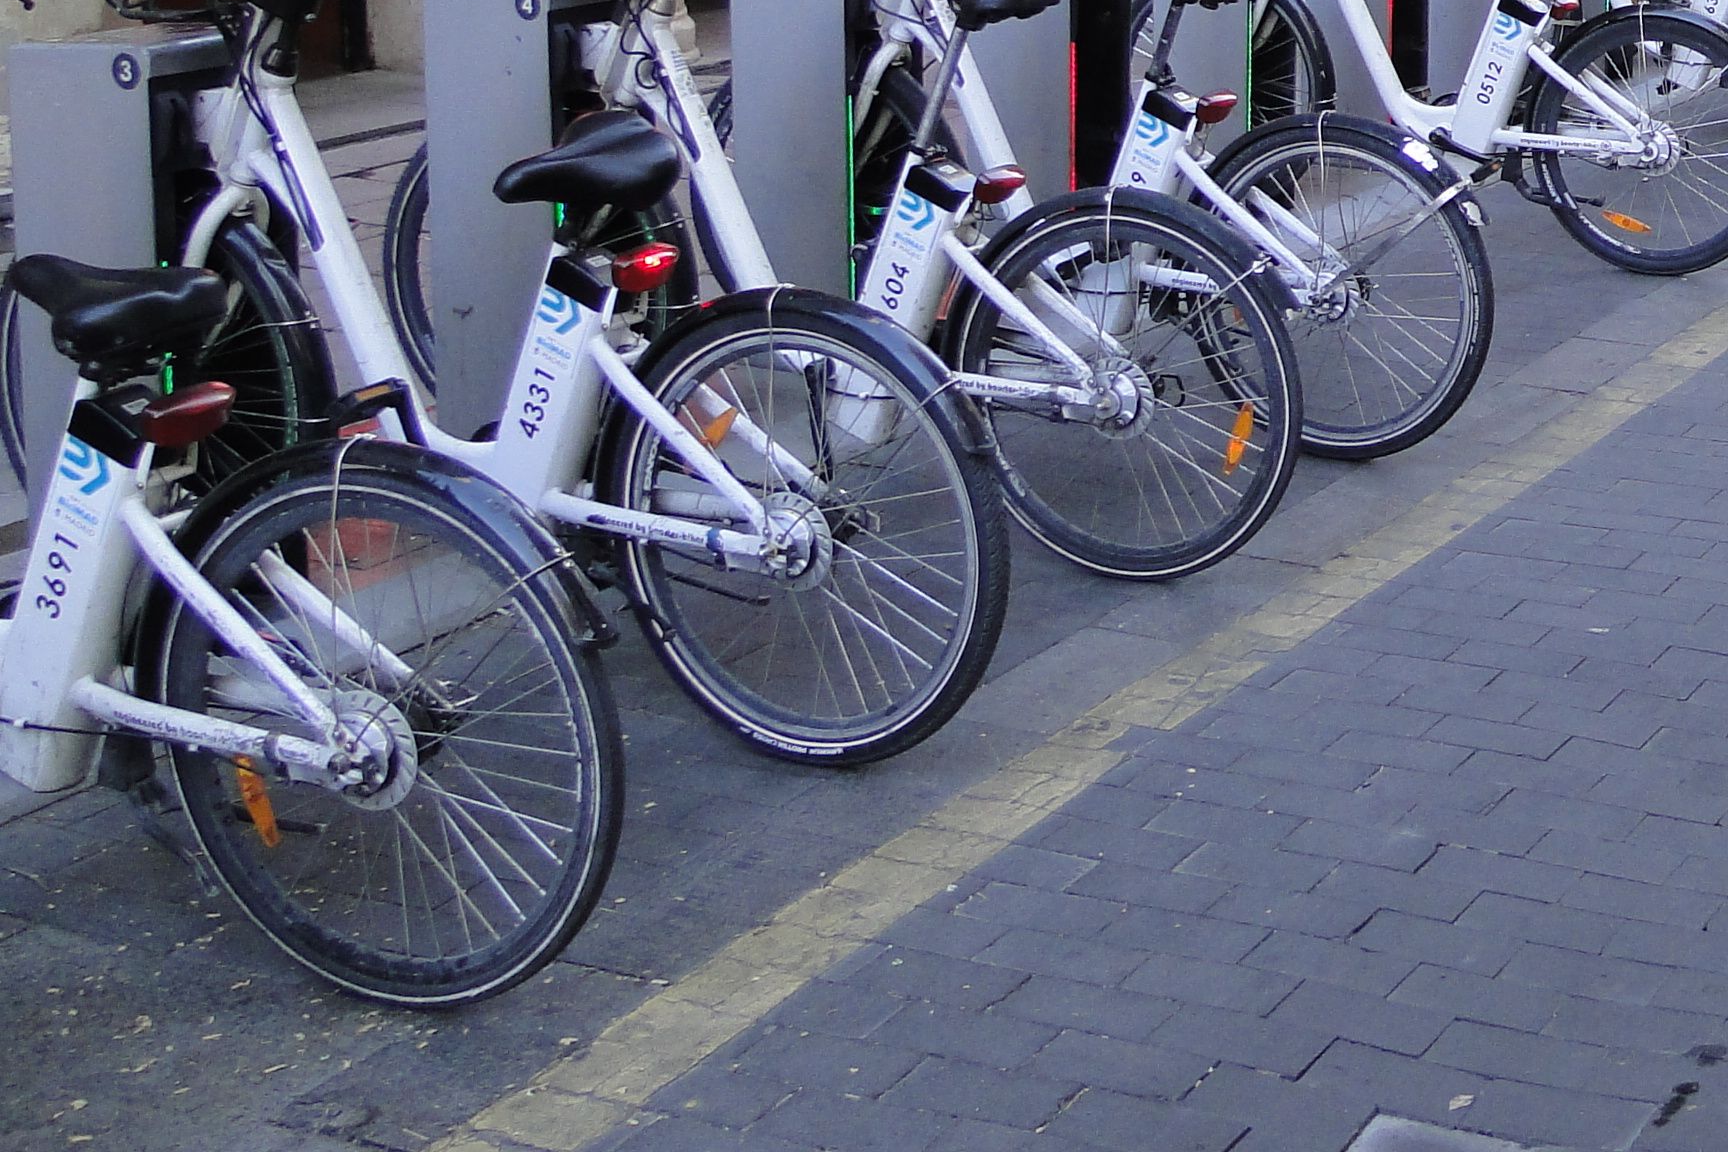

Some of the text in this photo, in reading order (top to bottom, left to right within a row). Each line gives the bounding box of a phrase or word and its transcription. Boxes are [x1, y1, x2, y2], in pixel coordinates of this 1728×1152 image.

[120, 60, 133, 82] 3
[1477, 61, 1503, 105] 0512
[881, 262, 910, 310] 604
[519, 367, 556, 439] 4331
[36, 532, 79, 619] 3691
